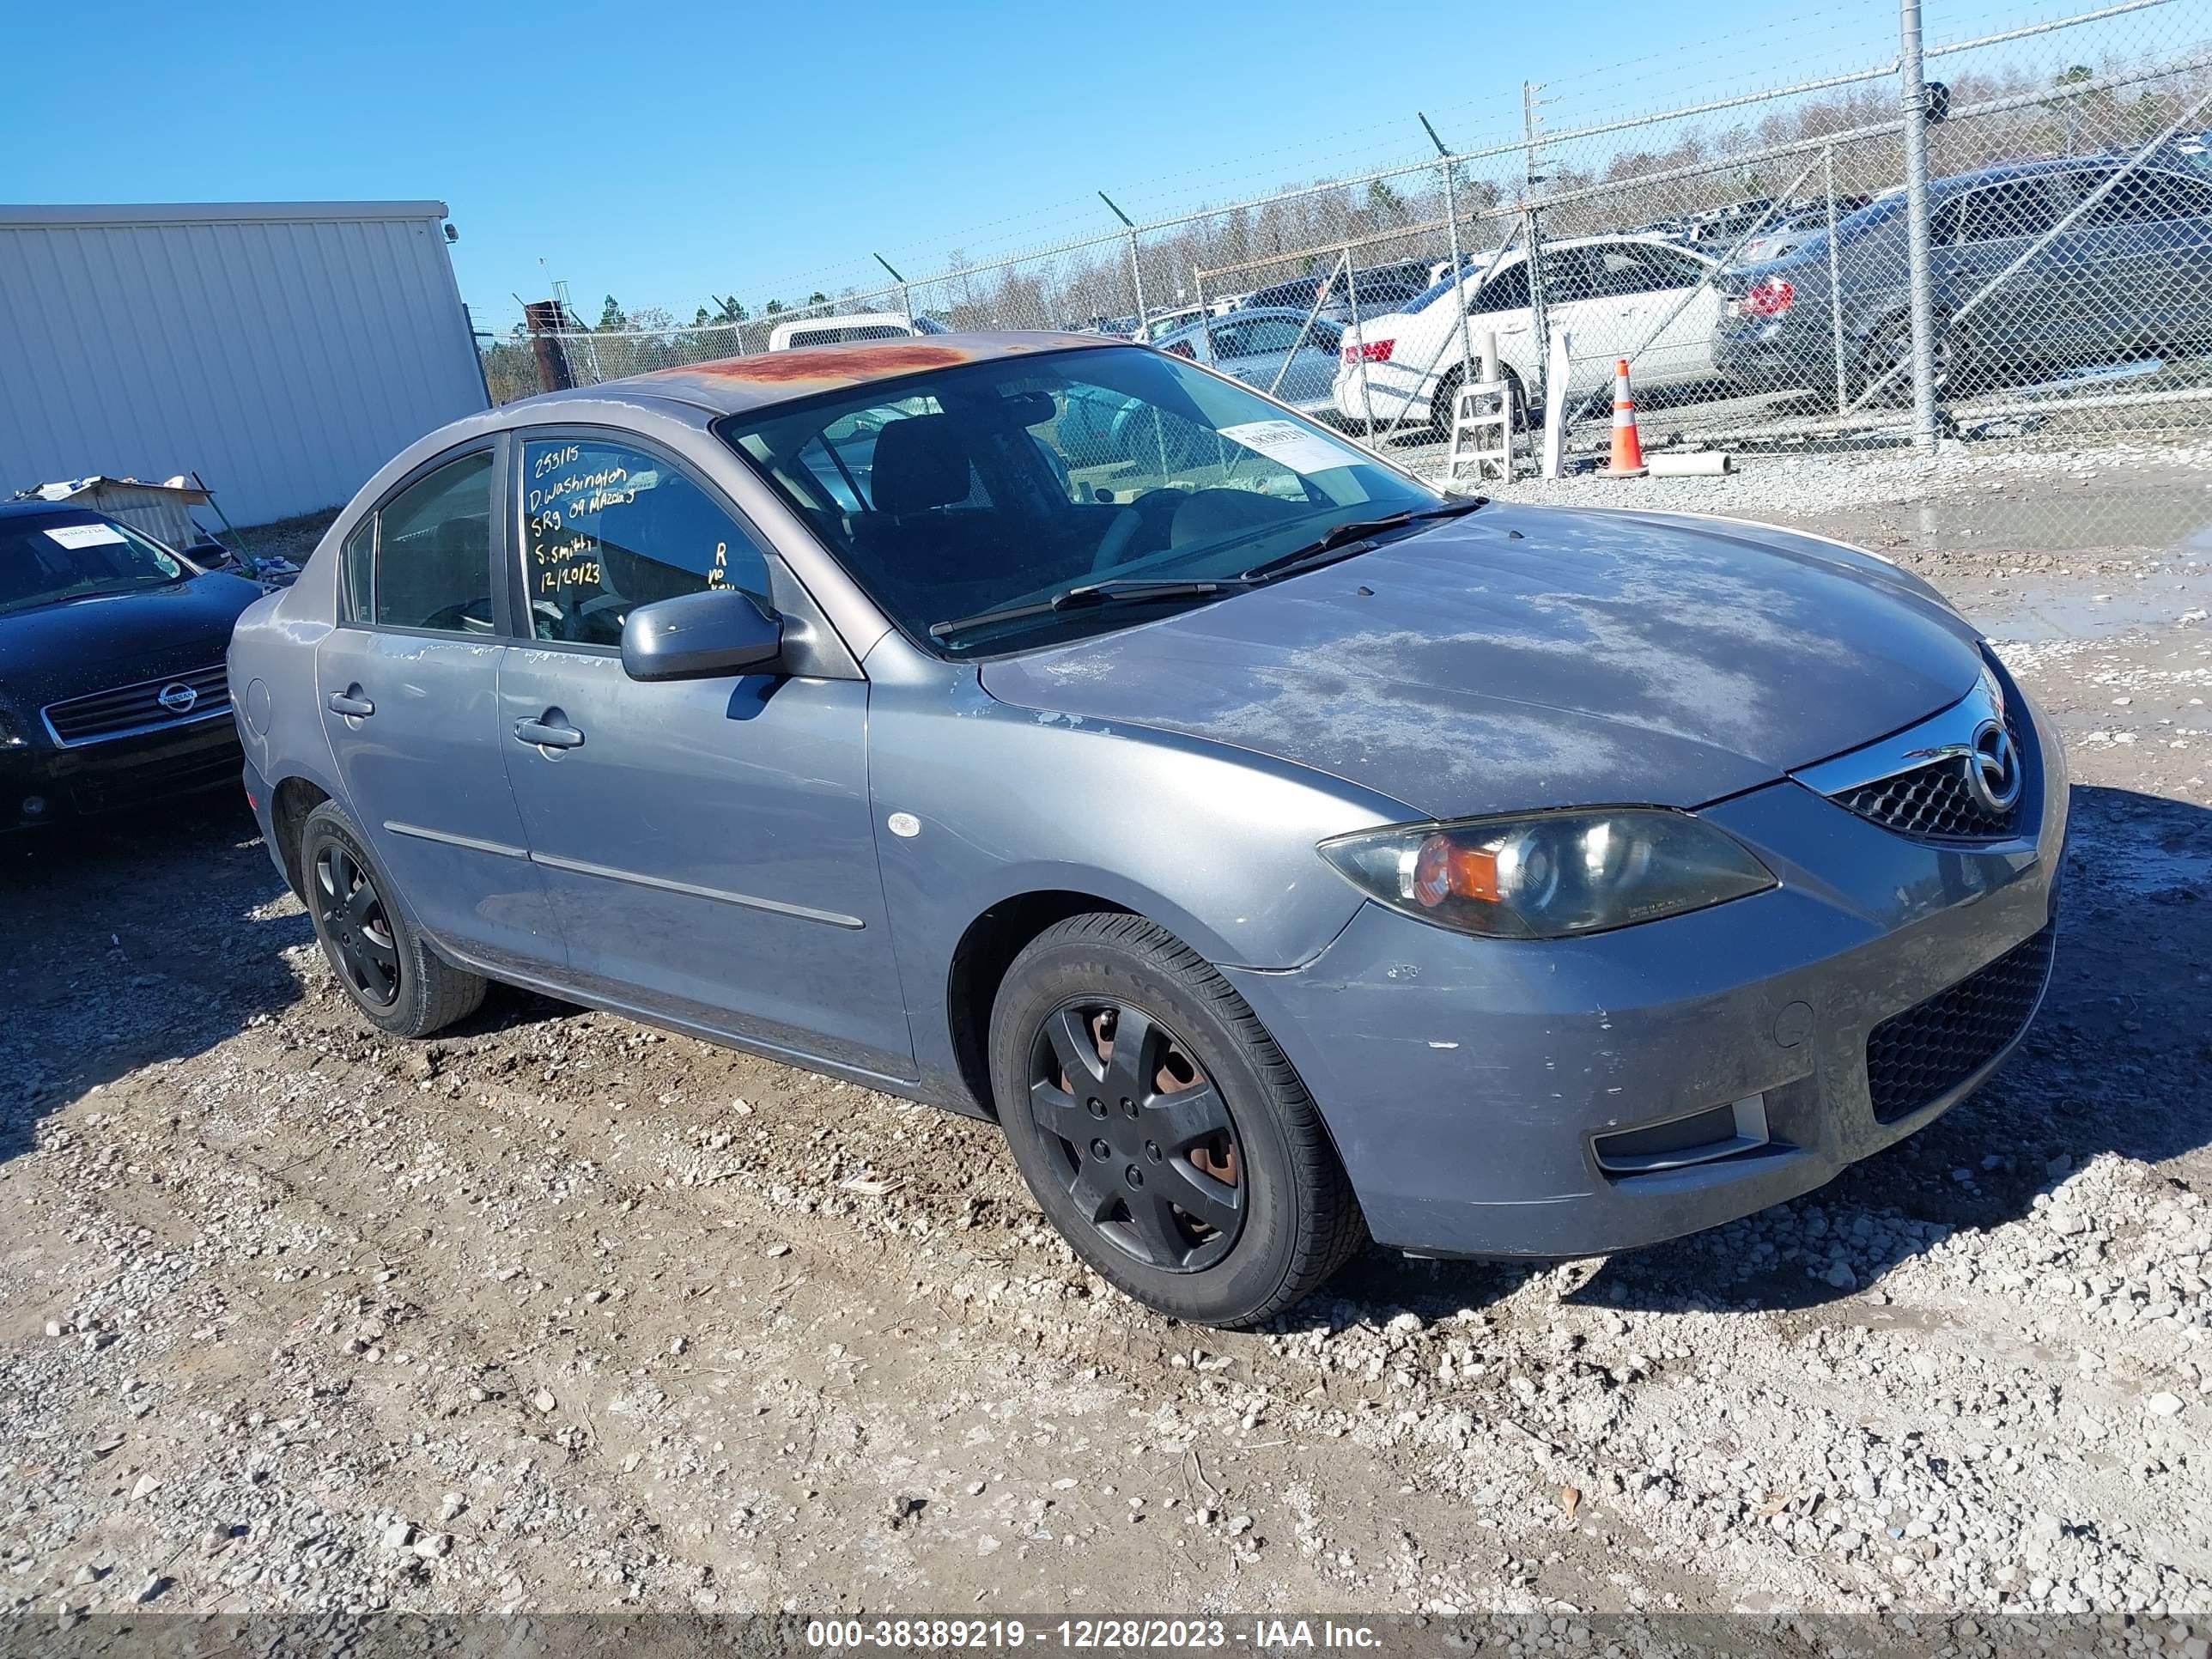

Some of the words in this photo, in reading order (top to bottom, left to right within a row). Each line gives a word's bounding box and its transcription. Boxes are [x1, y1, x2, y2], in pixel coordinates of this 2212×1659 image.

[535, 445, 580, 479] 253115
[568, 499, 586, 519] 09
[715, 542, 727, 567] R
[541, 562, 600, 593] 12/20/23
[163, 691, 194, 703] NISSAN
